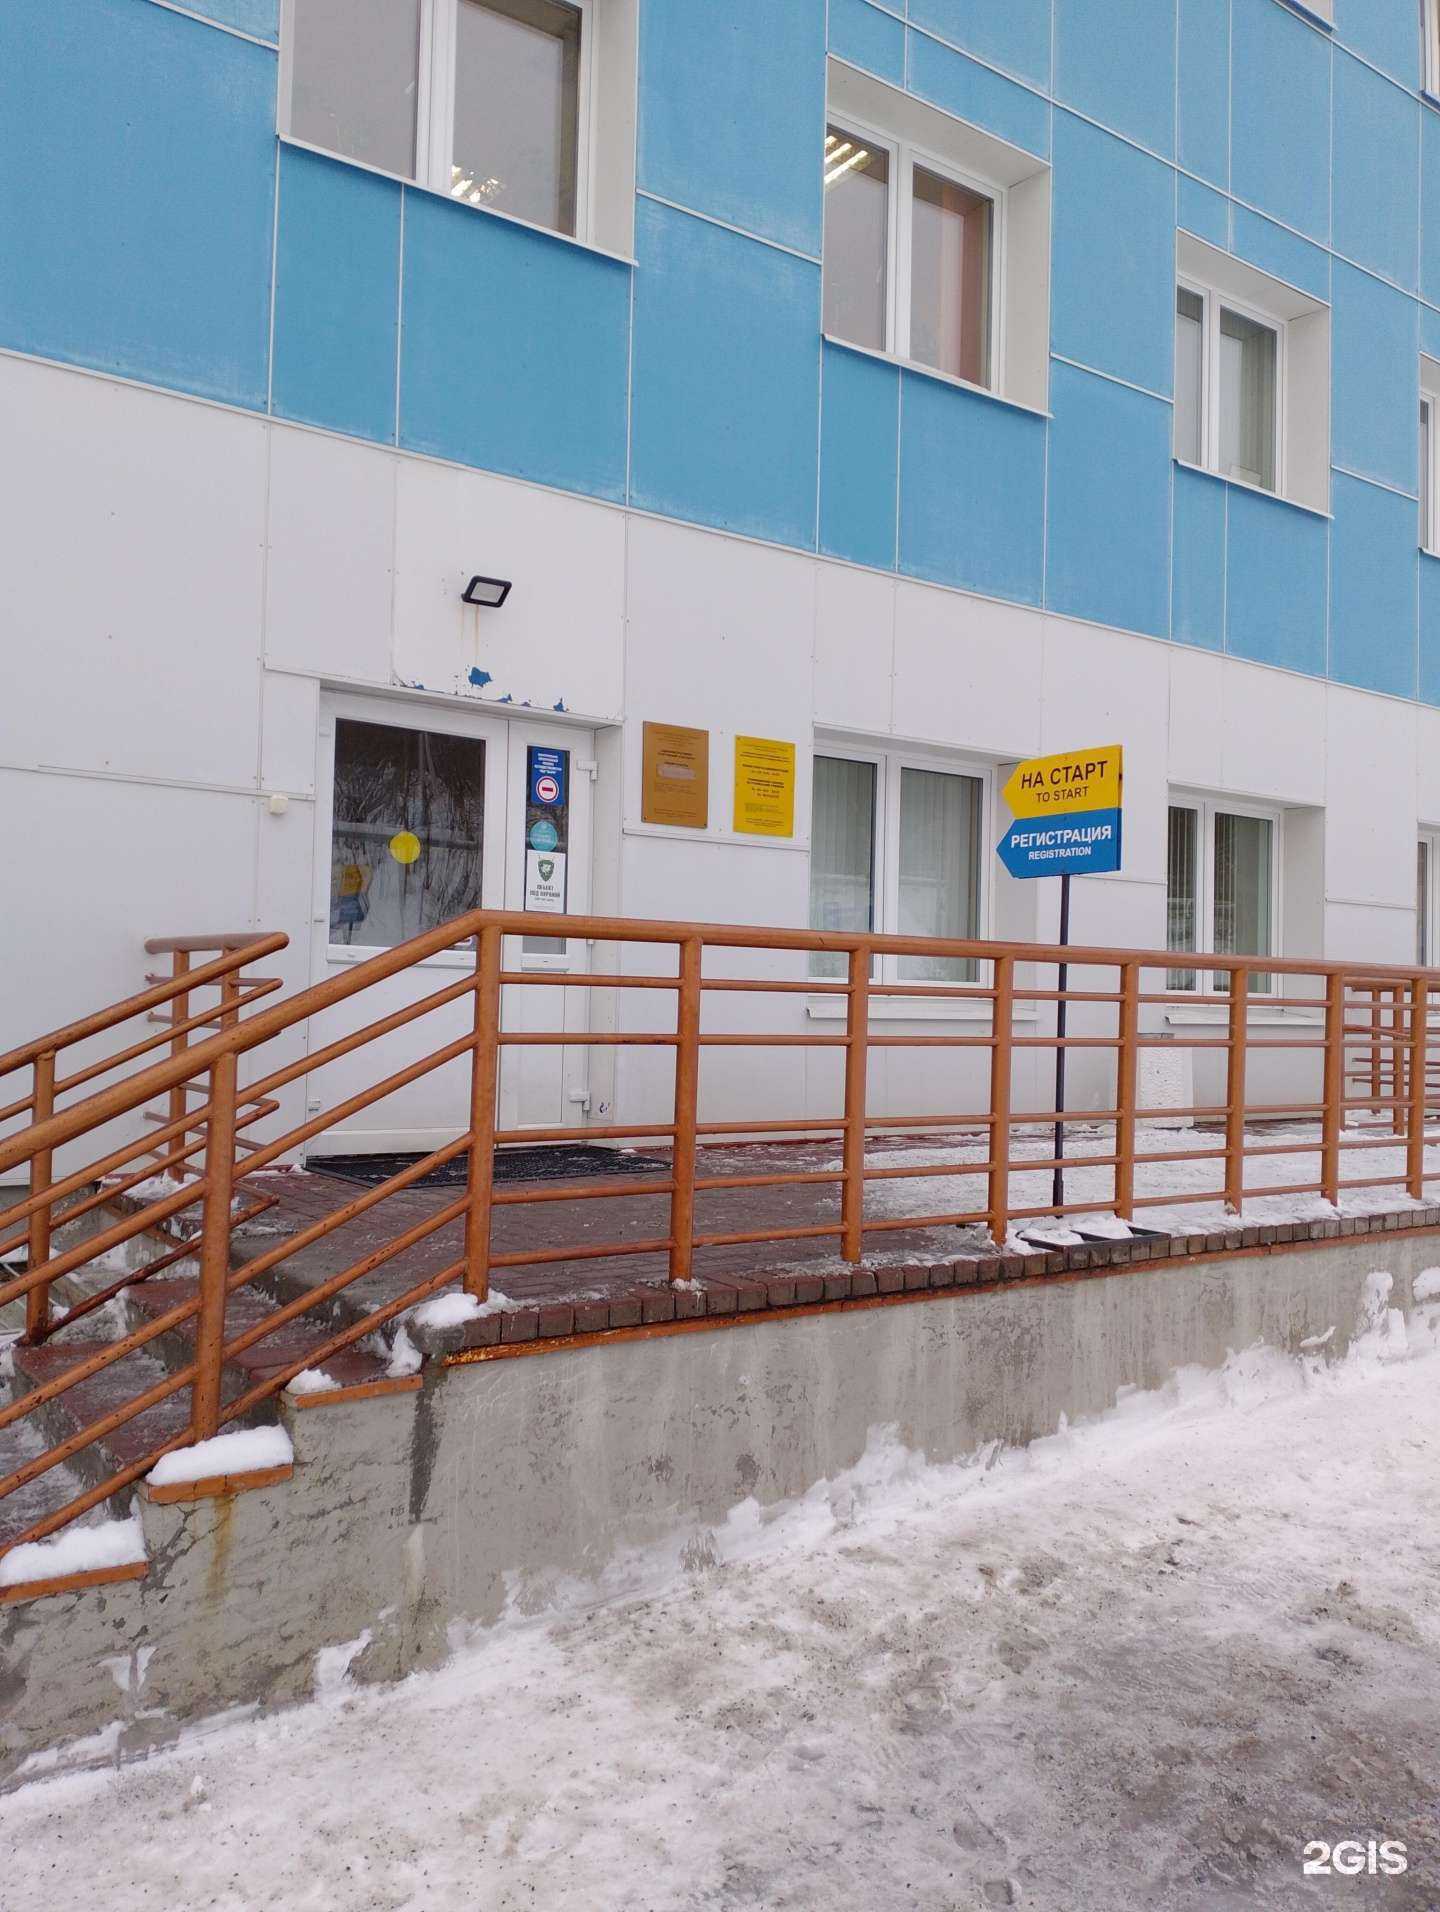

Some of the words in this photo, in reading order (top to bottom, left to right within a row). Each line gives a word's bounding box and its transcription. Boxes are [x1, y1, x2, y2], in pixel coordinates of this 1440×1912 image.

[1021, 770, 1045, 789] НА
[1050, 760, 1108, 785] СТАРТ
[1035, 792, 1051, 803] TO
[1053, 786, 1088, 801] START
[1010, 825, 1112, 849] РЕГИСТРАЦИЯ
[1028, 846, 1092, 860] REGISTRATION
